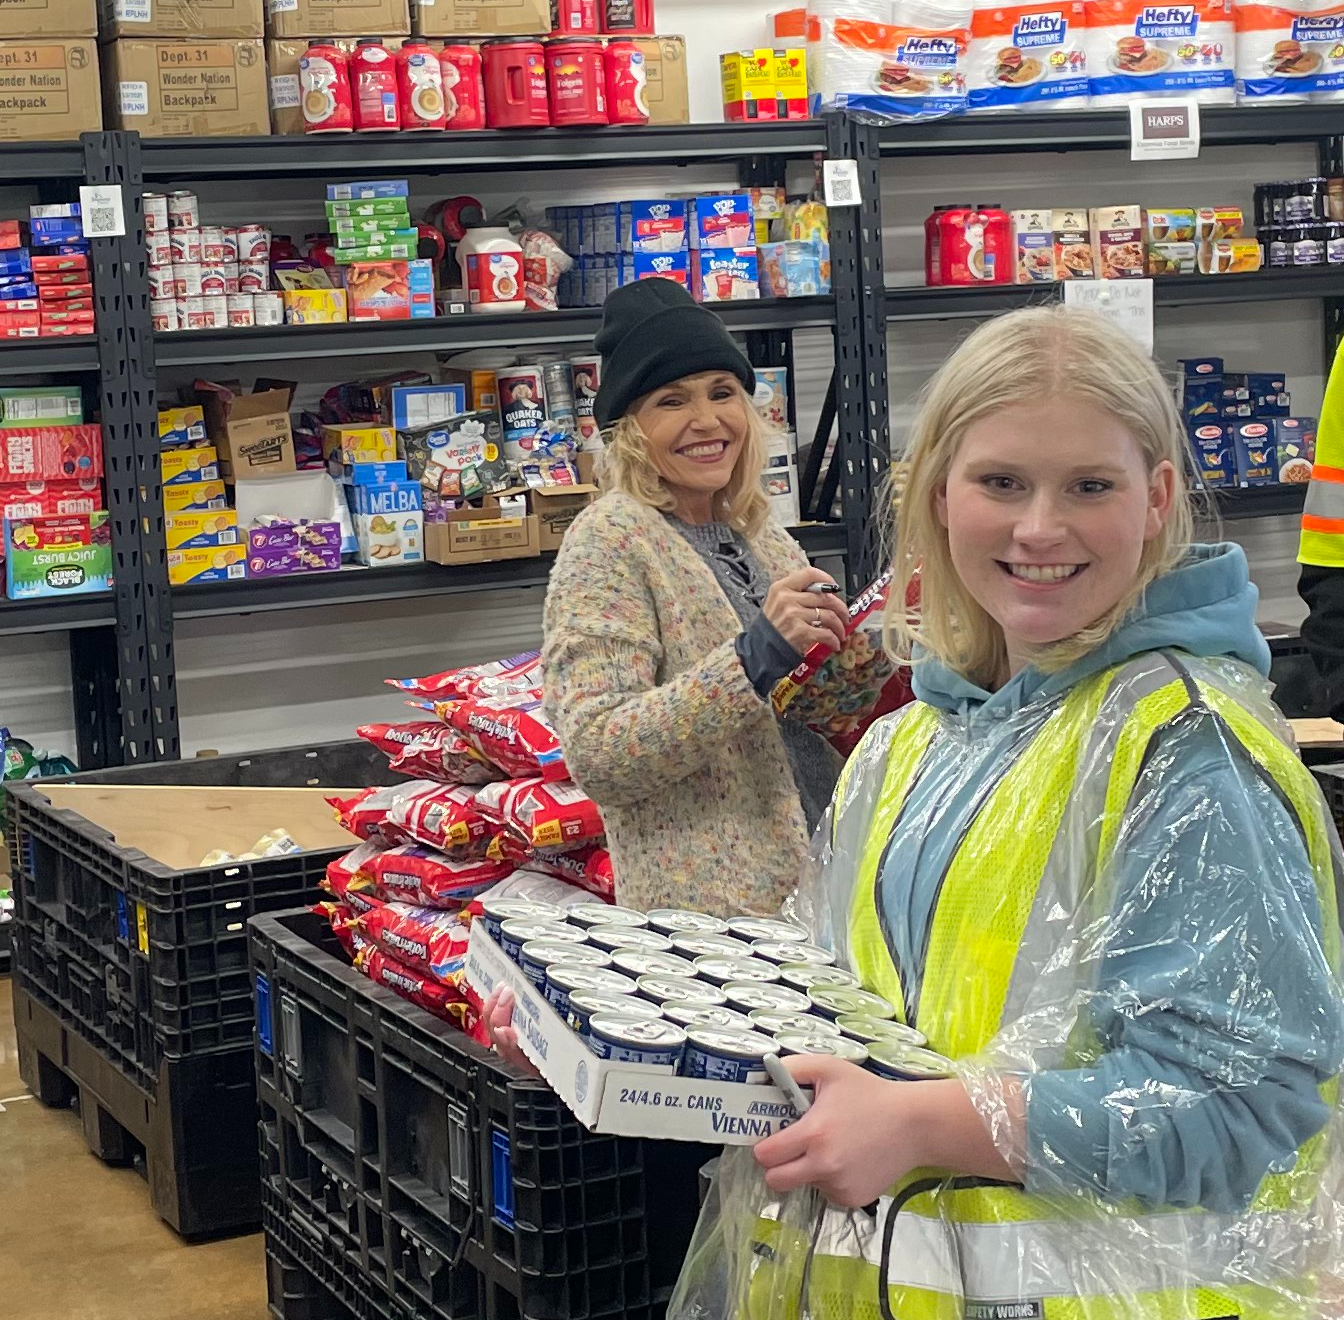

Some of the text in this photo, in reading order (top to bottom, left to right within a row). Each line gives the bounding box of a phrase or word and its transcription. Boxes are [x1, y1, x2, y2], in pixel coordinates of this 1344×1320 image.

[1145, 8, 1191, 24] Hefty
[1020, 16, 1060, 31] Hefty
[1139, 26, 1192, 37] SUPREME
[1296, 30, 1344, 40] SUPREME
[907, 38, 953, 54] Hefty
[1017, 34, 1060, 46] SUPREME
[24, 51, 38, 63] 31
[160, 50, 209, 64] Dept. 31
[29, 75, 62, 87] Nation
[162, 72, 231, 85] Wonder Nation
[164, 94, 217, 108] Backpack
[1147, 115, 1184, 127] HARPS
[709, 258, 750, 270] toaster
[505, 410, 543, 423] QUAKER
[514, 419, 537, 428] OATS
[370, 489, 417, 513] MELBA
[174, 518, 199, 528] Toasty
[32, 550, 96, 565] JUICY BURST
[184, 553, 208, 562] Toasty
[51, 576, 80, 586] BLACK
[567, 825, 580, 835] 23
[535, 832, 560, 843] FAMILY
[619, 1088, 724, 1111] 24/4.6 oz. CANS
[750, 1101, 798, 1117] ARMOU
[711, 1112, 772, 1138] VIENNA
[966, 1304, 1034, 1318] SAFETY WORKS
